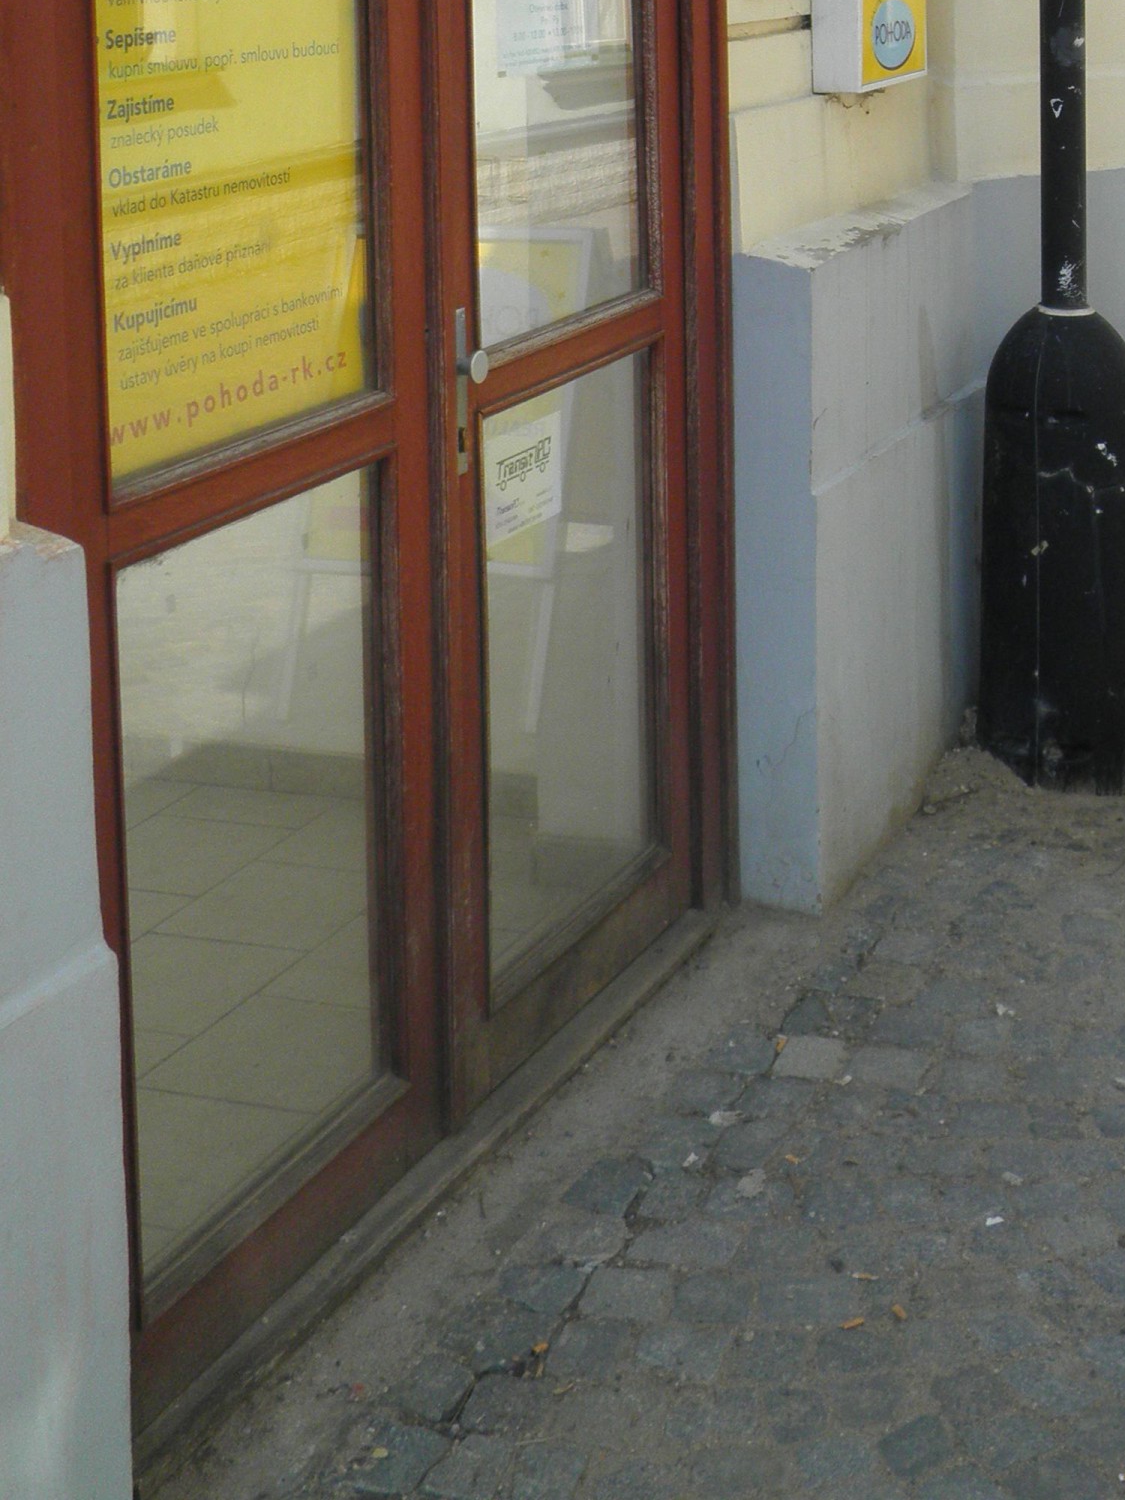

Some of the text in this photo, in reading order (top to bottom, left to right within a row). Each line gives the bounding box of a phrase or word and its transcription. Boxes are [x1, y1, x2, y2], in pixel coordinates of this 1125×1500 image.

[105, 26, 176, 53] Sepíšeme
[875, 20, 912, 45] POHODA
[108, 38, 341, 82] kupní smlouvu, popř. smlouvu budoucí
[107, 94, 175, 123] Zajistíme
[110, 115, 220, 150] znalecký posudek
[109, 159, 192, 188] Obstaráme
[112, 194, 146, 217] vklad
[150, 195, 167, 211] do
[170, 185, 220, 206] Katastru
[109, 231, 182, 265] Vyplníme
[115, 276, 128, 291] za
[131, 265, 174, 286] klienta
[178, 250, 223, 274] daňové
[113, 298, 198, 333] Kupujícímu
[118, 284, 343, 362] zajišťujeme ve spolupráci s bankovními
[120, 367, 161, 391] ústavy
[165, 354, 198, 377] úvěry
[202, 350, 216, 365] na
[219, 334, 252, 361] koupi
[110, 350, 347, 446] www.pohoda-rk.cz
